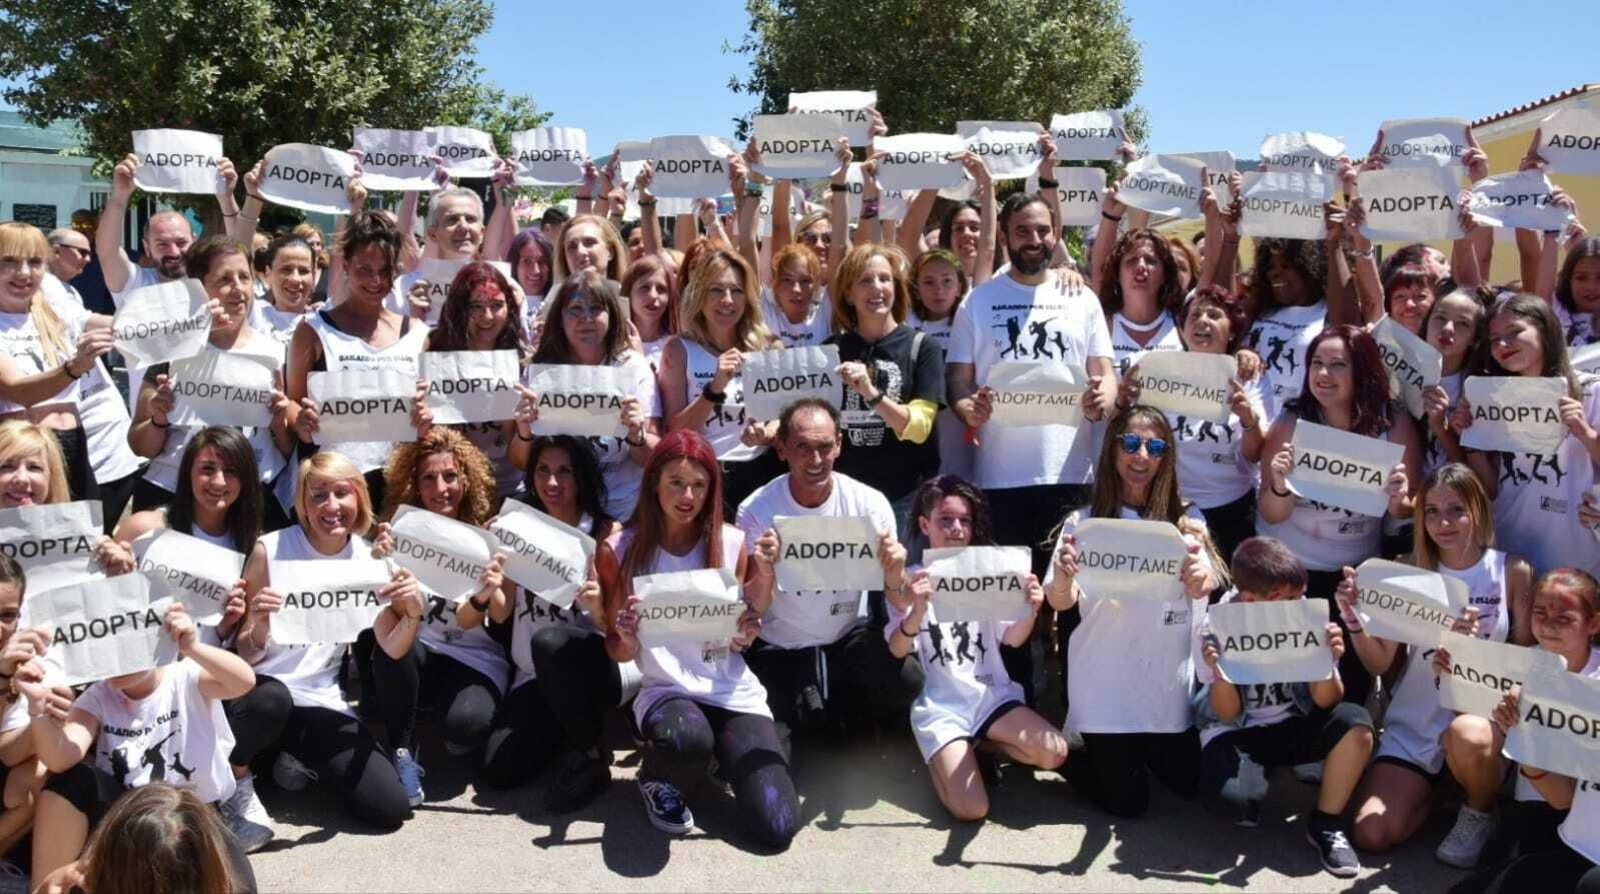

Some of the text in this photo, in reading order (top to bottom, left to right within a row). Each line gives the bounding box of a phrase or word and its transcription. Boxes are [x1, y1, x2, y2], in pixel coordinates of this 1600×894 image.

[1057, 127, 1117, 140] ADOPTA
[520, 148, 583, 162] ADOPTA
[760, 139, 834, 154] ADOPTA
[968, 142, 1038, 156] ADOPTA
[1382, 143, 1464, 158] ADOPTAME
[144, 152, 217, 168] ADOPTA
[363, 152, 430, 168] ADOPTA
[655, 159, 724, 174] ADOPTA
[1265, 154, 1337, 171] ADOPTAME
[269, 164, 345, 190] ADOPTA
[1241, 197, 1322, 219] ADOPTAME
[1369, 195, 1454, 213] ADOPTA
[173, 380, 270, 404] ADOPTAME
[429, 377, 508, 395] ADOPTA
[753, 373, 833, 394] ADOPTA
[1136, 375, 1226, 404] ADOPTAME
[320, 399, 407, 416] ADOPTA
[539, 393, 622, 410] ADOPTA
[992, 392, 1077, 406] ADOPTAME
[1475, 405, 1560, 424] ADOPTA
[1297, 452, 1383, 486] ADOPTA
[494, 526, 577, 583] ADOPTAME
[784, 542, 874, 560] ADOPTA
[1077, 551, 1179, 576] ADOPTAME
[936, 575, 1022, 592] ADOPTA
[284, 590, 380, 609] ADOPTA
[1356, 588, 1453, 627] ADOPTAME
[639, 602, 738, 620] ADOPTAME
[52, 608, 162, 647] ADOPTA
[1223, 630, 1320, 652] ADOPTA
